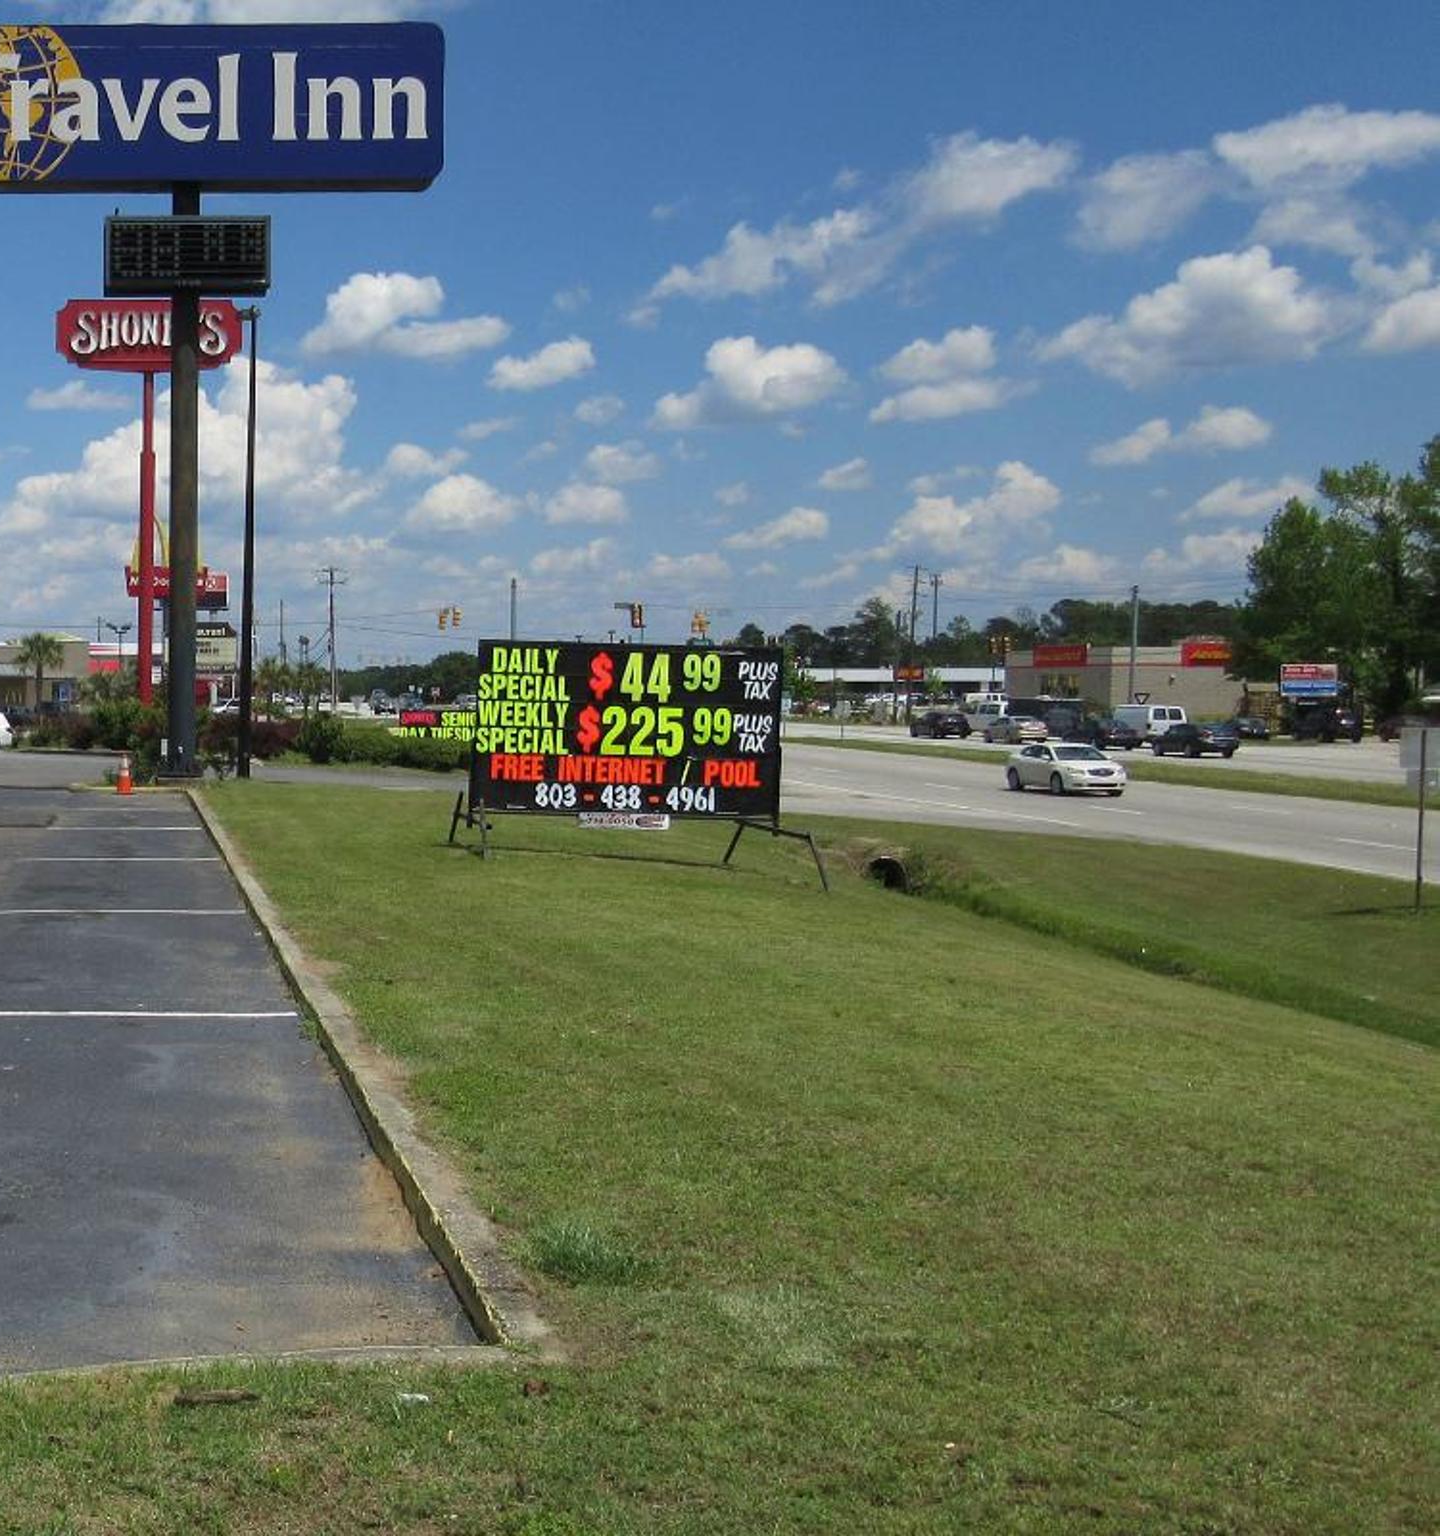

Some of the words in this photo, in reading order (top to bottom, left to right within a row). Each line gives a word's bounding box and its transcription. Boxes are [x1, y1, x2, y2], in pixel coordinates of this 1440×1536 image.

[272, 52, 428, 140] Inn
[70, 311, 226, 355] SHON'S
[492, 647, 559, 674] DAILY
[683, 654, 721, 692] 99
[738, 661, 778, 681] PLUS
[478, 674, 570, 701] SPECIAL
[744, 681, 772, 700] TAX
[441, 711, 476, 726] SENIO
[478, 701, 569, 728] WEEKLY
[693, 708, 732, 745] 99
[733, 714, 773, 734] PLUS
[431, 727, 475, 741] TUESD
[476, 727, 569, 754] SPECIAL
[738, 733, 767, 753] TAX
[490, 753, 544, 781] FREE
[557, 755, 666, 785] INTERNET
[704, 760, 762, 788] POOL
[534, 783, 577, 808] 803
[600, 785, 642, 810] 438
[666, 786, 715, 812] 4961
